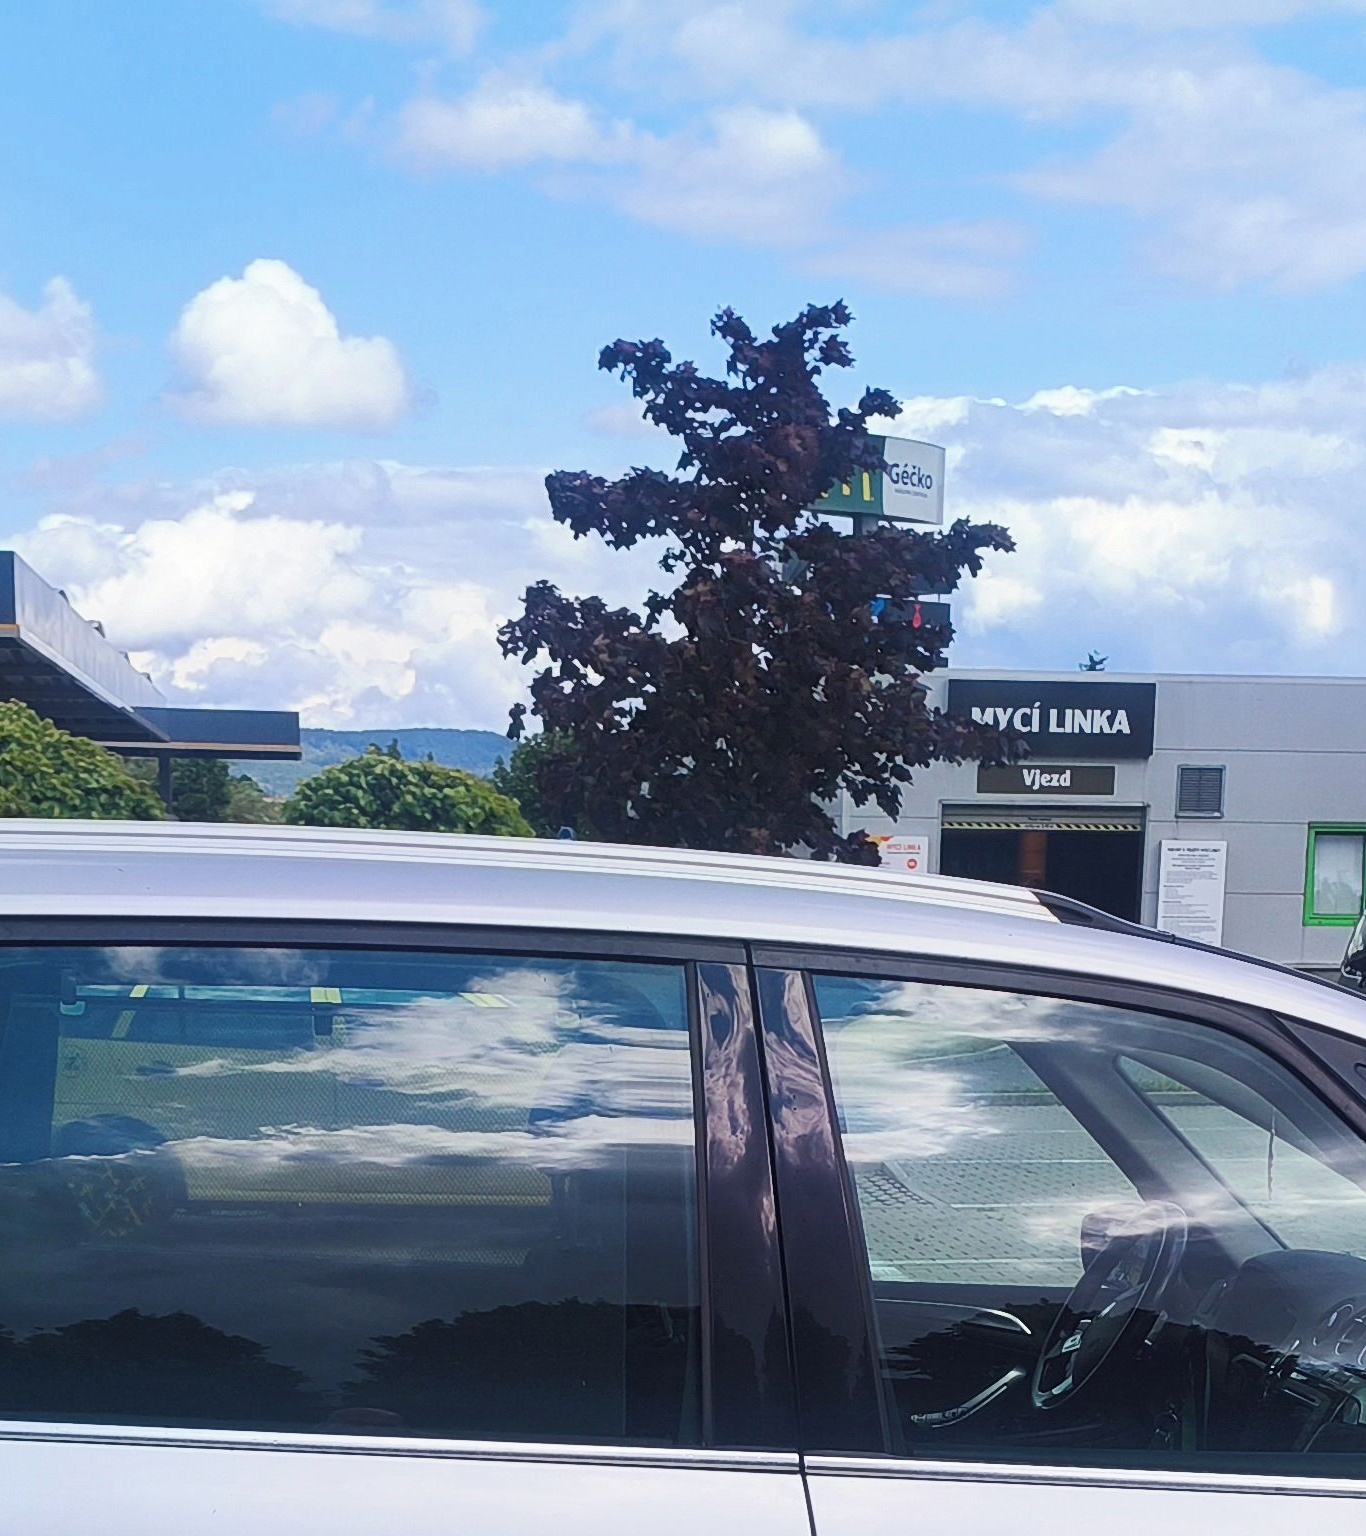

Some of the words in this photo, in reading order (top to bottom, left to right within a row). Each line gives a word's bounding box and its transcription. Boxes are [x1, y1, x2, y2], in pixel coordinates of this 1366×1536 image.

[889, 463, 933, 490] Géčko
[971, 701, 1041, 733] MYCÍ
[1048, 708, 1131, 735] LINKA
[1022, 768, 1071, 790] Vjezd
